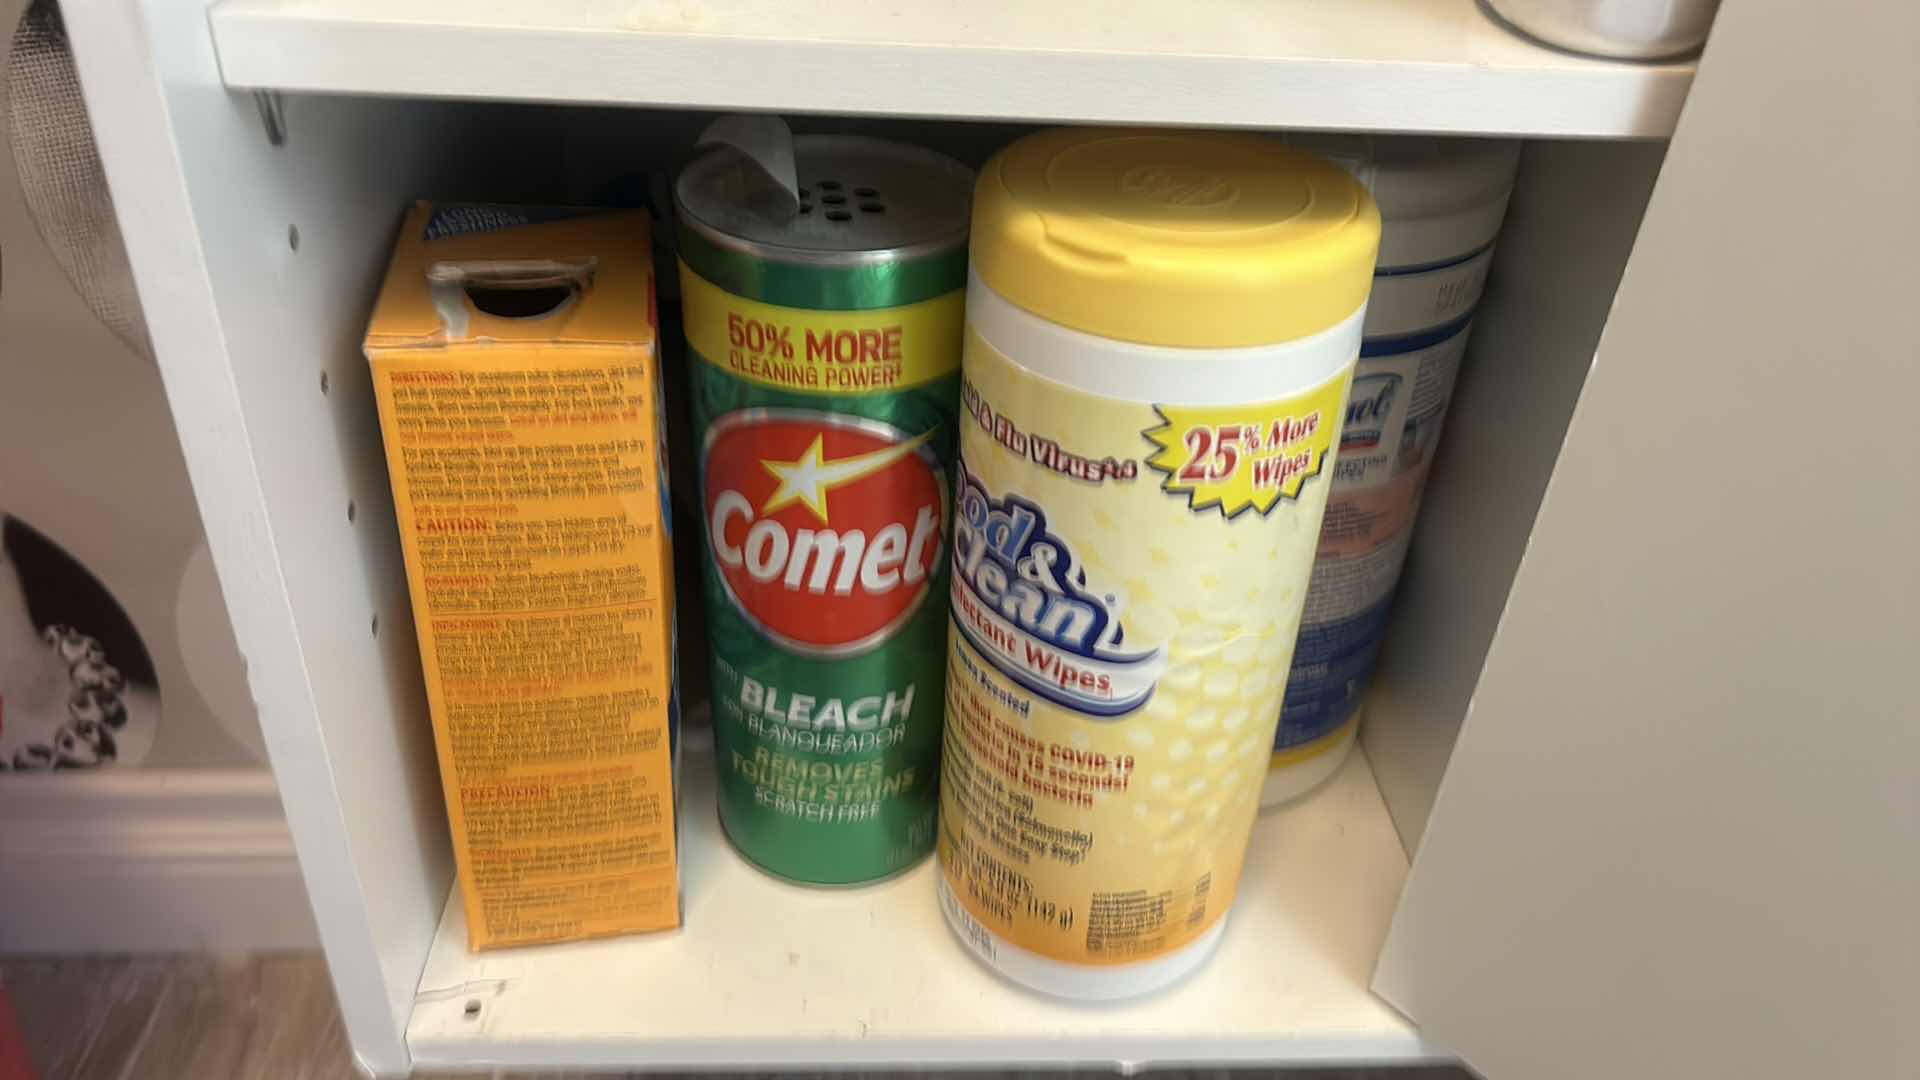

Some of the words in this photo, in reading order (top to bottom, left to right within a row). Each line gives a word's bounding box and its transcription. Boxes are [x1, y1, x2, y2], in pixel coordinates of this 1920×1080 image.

[727, 311, 795, 359] 50%
[806, 326, 904, 365] MORE
[730, 349, 819, 386] CLEANING
[994, 413, 1028, 459] Flu
[1265, 410, 1320, 450] More
[1253, 448, 1314, 488] Wipes
[416, 518, 494, 535] CAUTION:
[710, 489, 940, 597] Comet
[1016, 540, 1068, 596] &
[1024, 638, 1112, 692] Wipes
[740, 675, 916, 733] BLEACH
[747, 714, 907, 754] BLANQUEADOR
[731, 749, 815, 801] TOUGH
[823, 767, 917, 803] STAINS
[755, 746, 885, 785] REMOVES
[1049, 742, 1136, 772] COVID-19
[1049, 766, 1131, 793] seconds!
[755, 784, 833, 823] SCRATCH
[837, 800, 881, 825] FREE
